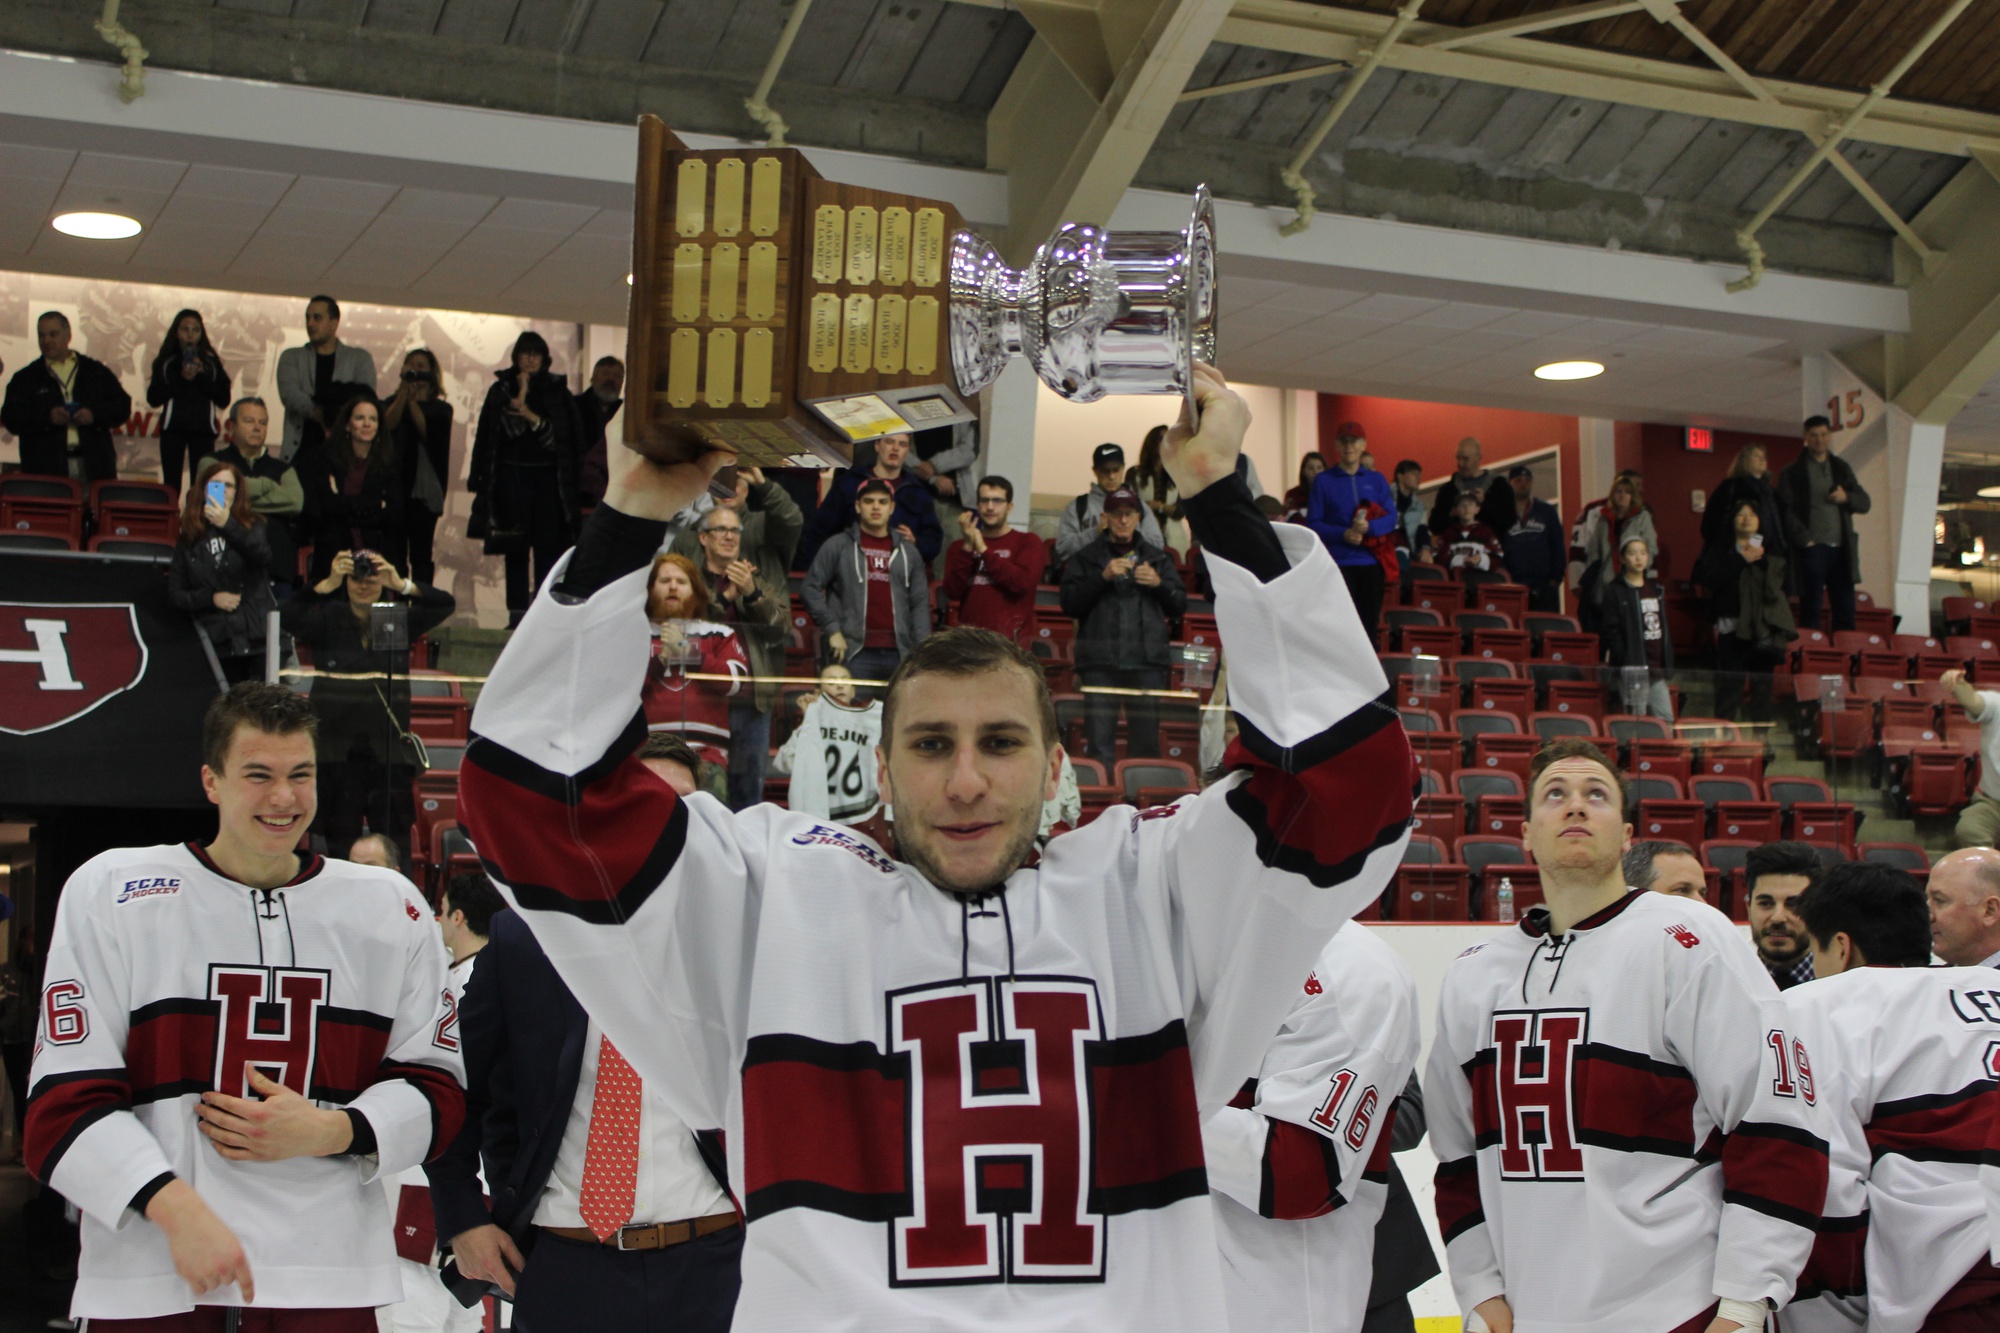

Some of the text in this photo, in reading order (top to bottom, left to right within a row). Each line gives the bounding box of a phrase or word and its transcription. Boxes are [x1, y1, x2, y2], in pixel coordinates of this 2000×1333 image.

[825, 221, 833, 269] HARVARD
[852, 222, 863, 270] HARVARD
[884, 217, 894, 276] DARTMOUTH
[896, 235, 905, 260] 2002
[917, 218, 928, 277] DARTMOUTH
[929, 236, 938, 260] 2001
[815, 309, 826, 357] HARVARD
[860, 321, 869, 347] 2007
[881, 311, 891, 358] HARVARD
[1827, 389, 1865, 432] 15
[874, 557, 884, 569] H
[0, 618, 84, 690] H
[825, 744, 863, 797] 26
[807, 825, 898, 871] ECAC
[816, 836, 896, 873] HOCKEY
[124, 877, 181, 893] ECAC
[131, 887, 179, 899] HOCKEY
[206, 963, 332, 1108] H
[1767, 1029, 1817, 1107] 19
[1309, 1068, 1379, 1153] 16
[1489, 1007, 1590, 1182] H
[885, 975, 1108, 1289] H
